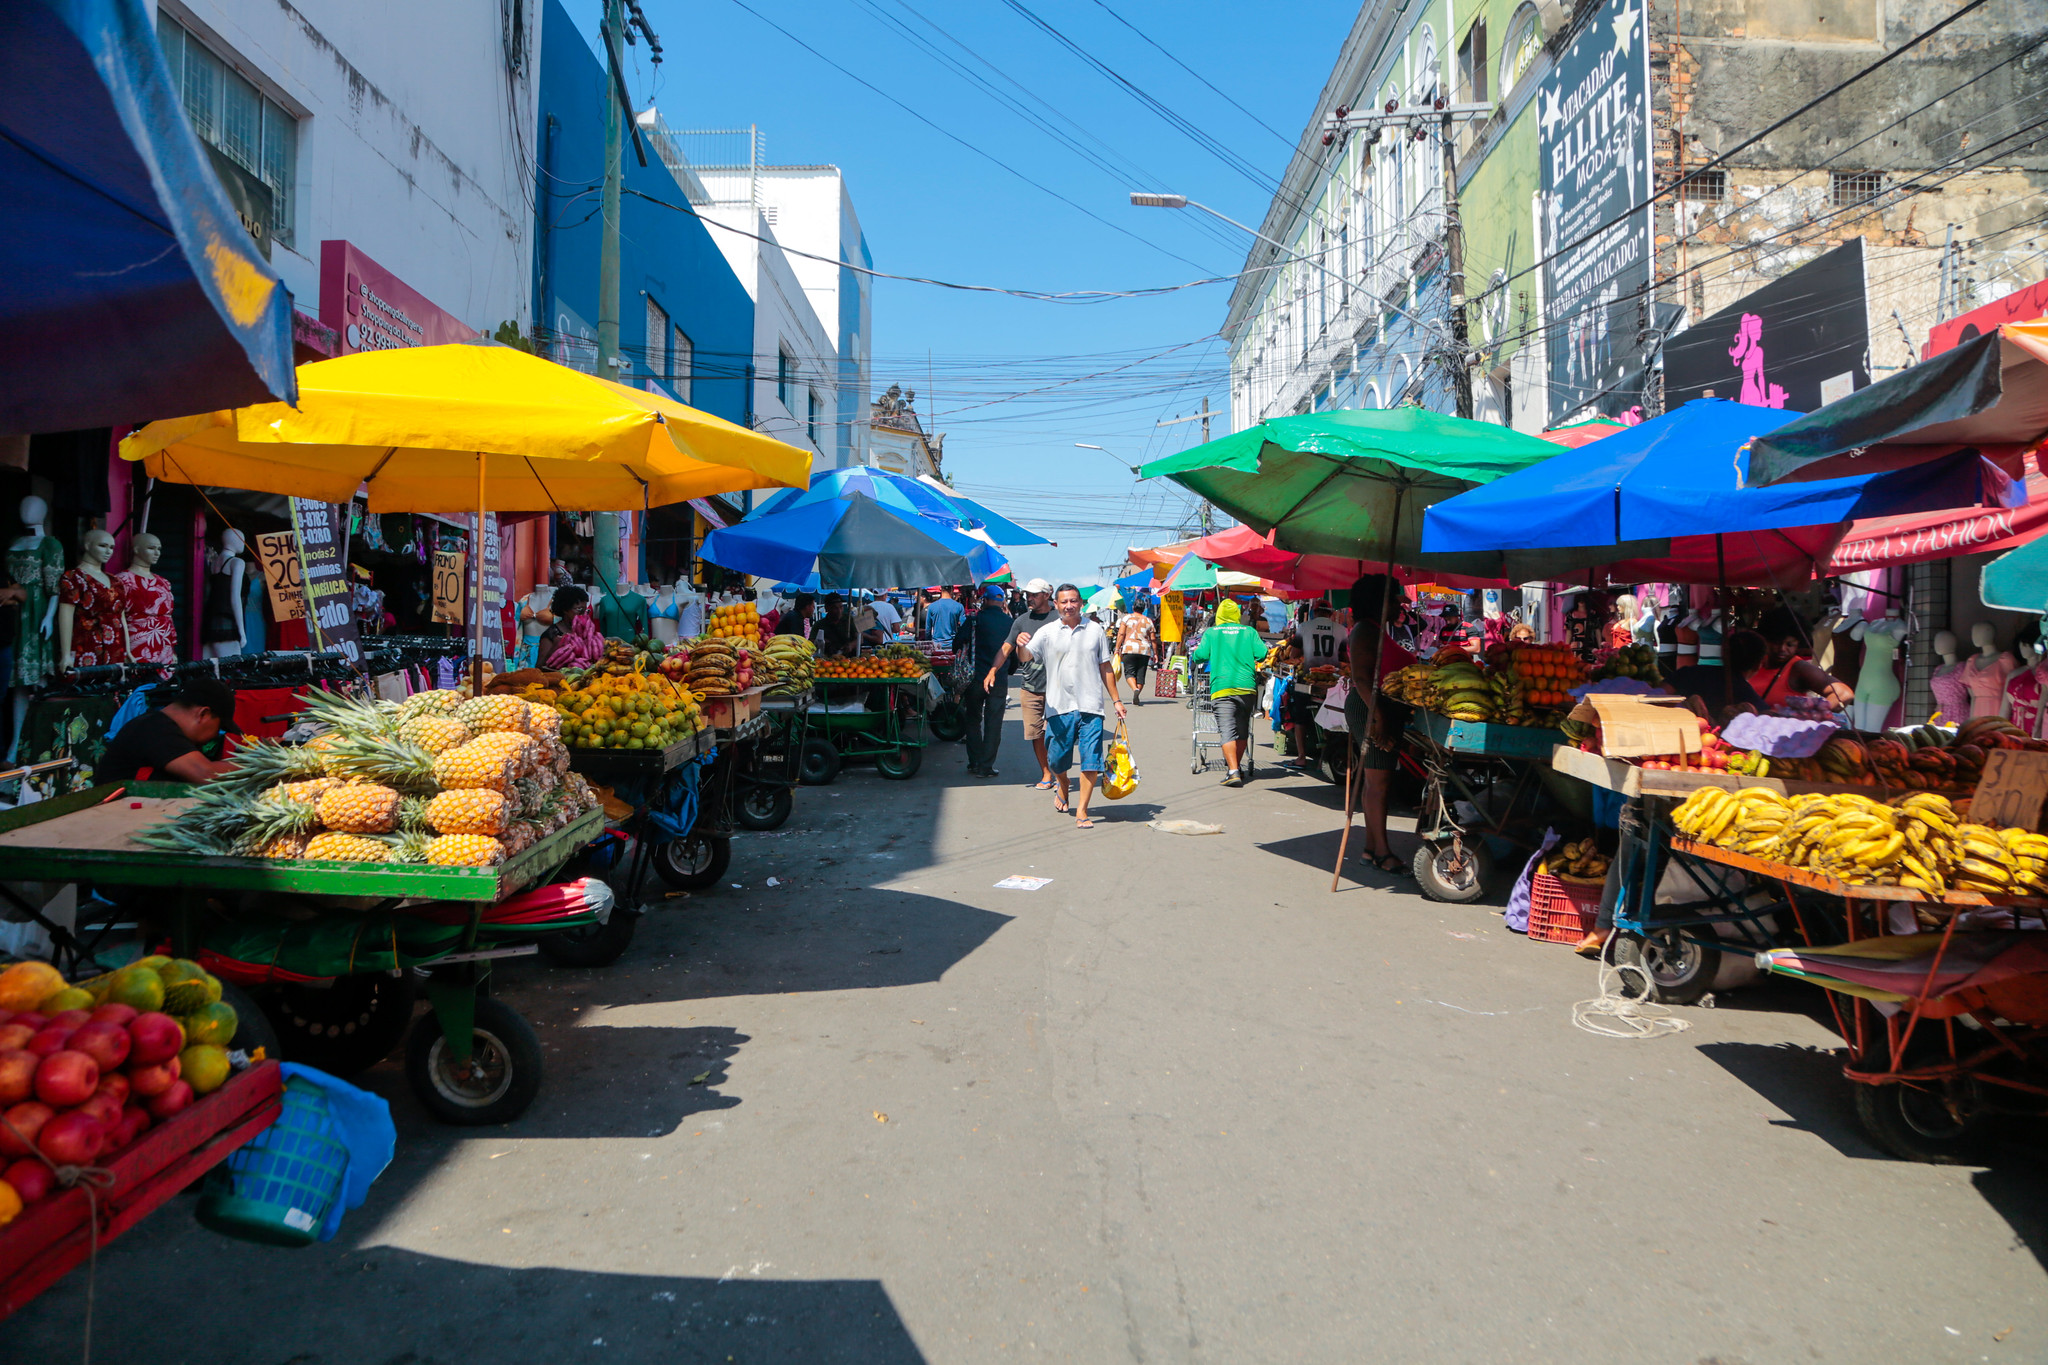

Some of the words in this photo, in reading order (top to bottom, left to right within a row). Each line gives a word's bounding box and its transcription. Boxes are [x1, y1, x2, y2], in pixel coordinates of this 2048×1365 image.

[1561, 50, 1614, 130] ATACADÃO
[1552, 72, 1627, 188] ELLITE
[1576, 129, 1622, 192] MODAS
[1580, 271, 1592, 299] NO
[1593, 234, 1639, 288] ATACADO!
[360, 324, 373, 344] 92
[361, 304, 393, 335] Shopping
[1911, 509, 2016, 555] FASHION
[437, 570, 459, 603] 10
[1312, 634, 1335, 657] 10
[1985, 751, 2008, 789] 3
